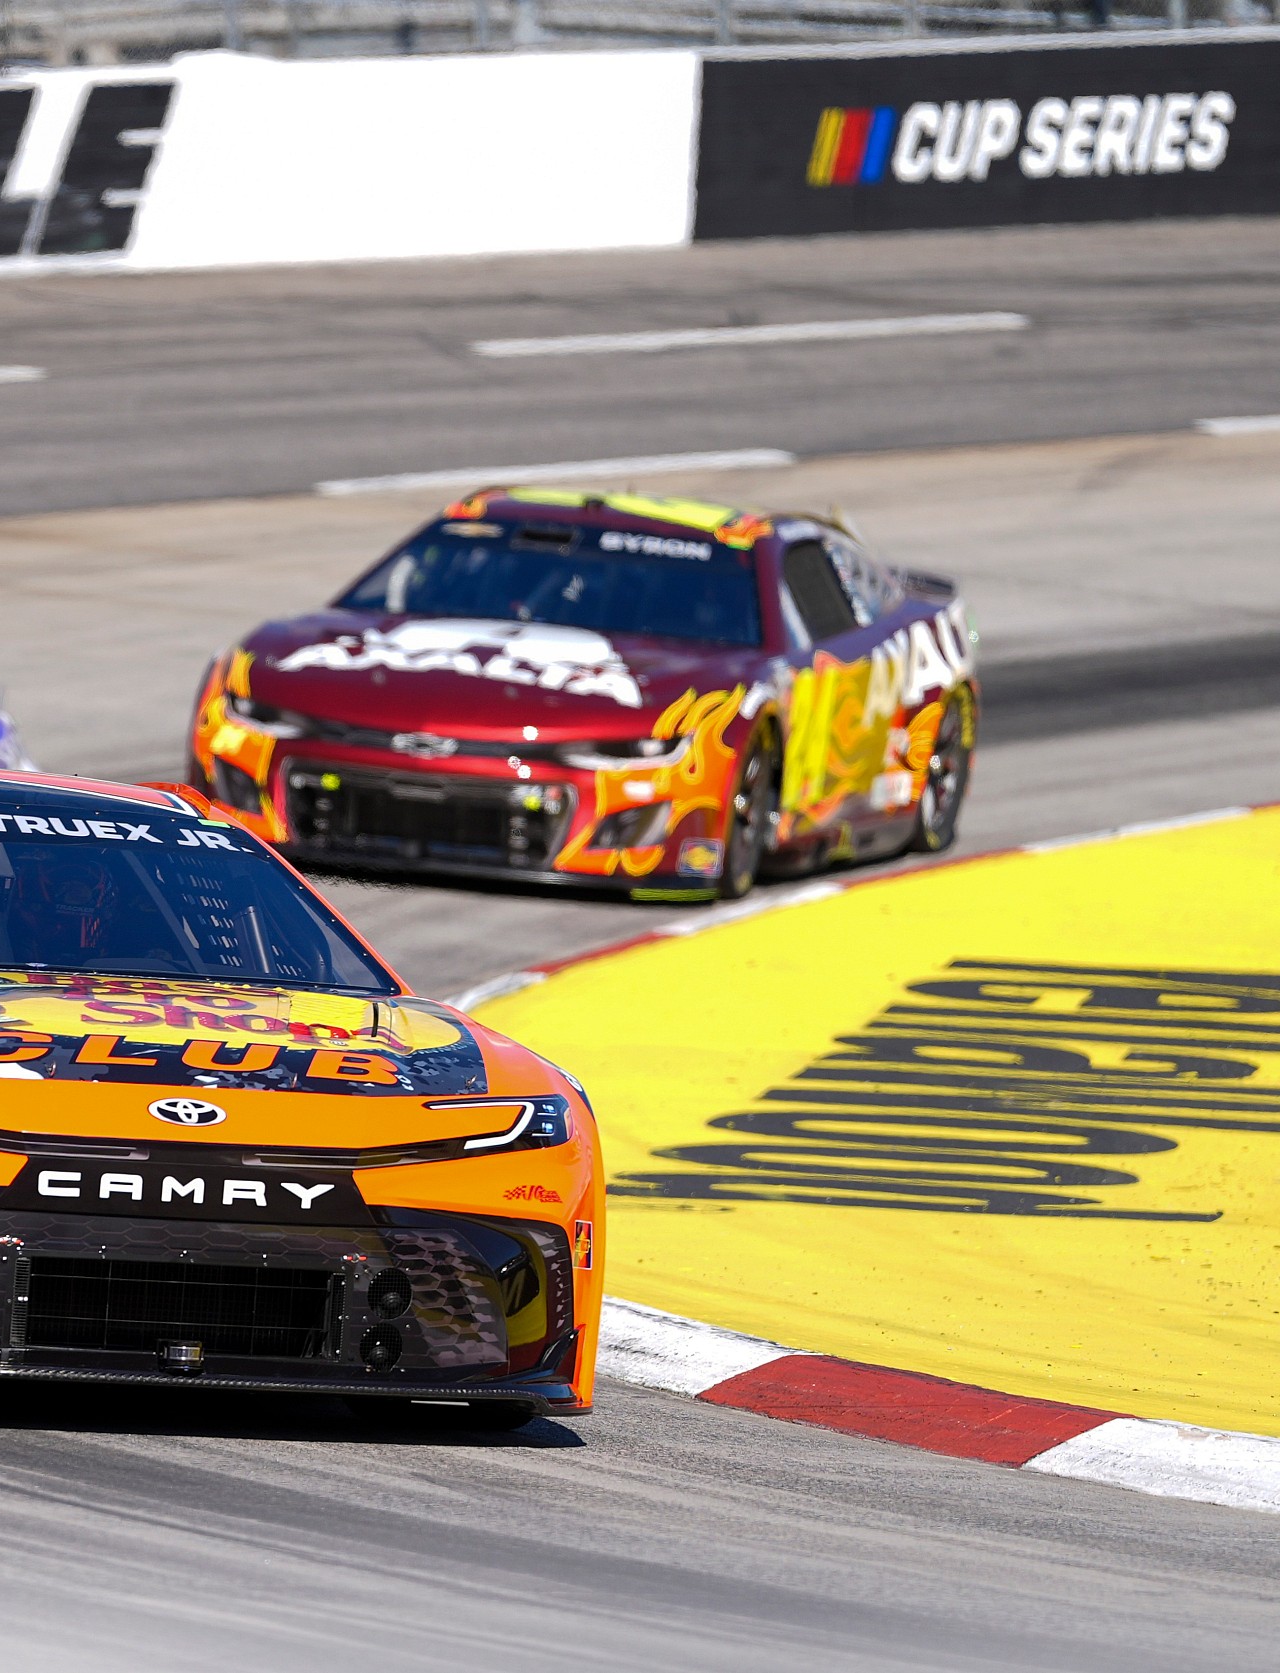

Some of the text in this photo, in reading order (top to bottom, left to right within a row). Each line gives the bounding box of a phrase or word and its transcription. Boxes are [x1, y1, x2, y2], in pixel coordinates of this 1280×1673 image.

[892, 91, 1237, 184] CUP SERIES
[600, 531, 713, 561] BYRON
[176, 828, 255, 853] JR.
[58, 984, 258, 1011] Pro
[38, 1170, 335, 1210] CAMRY
